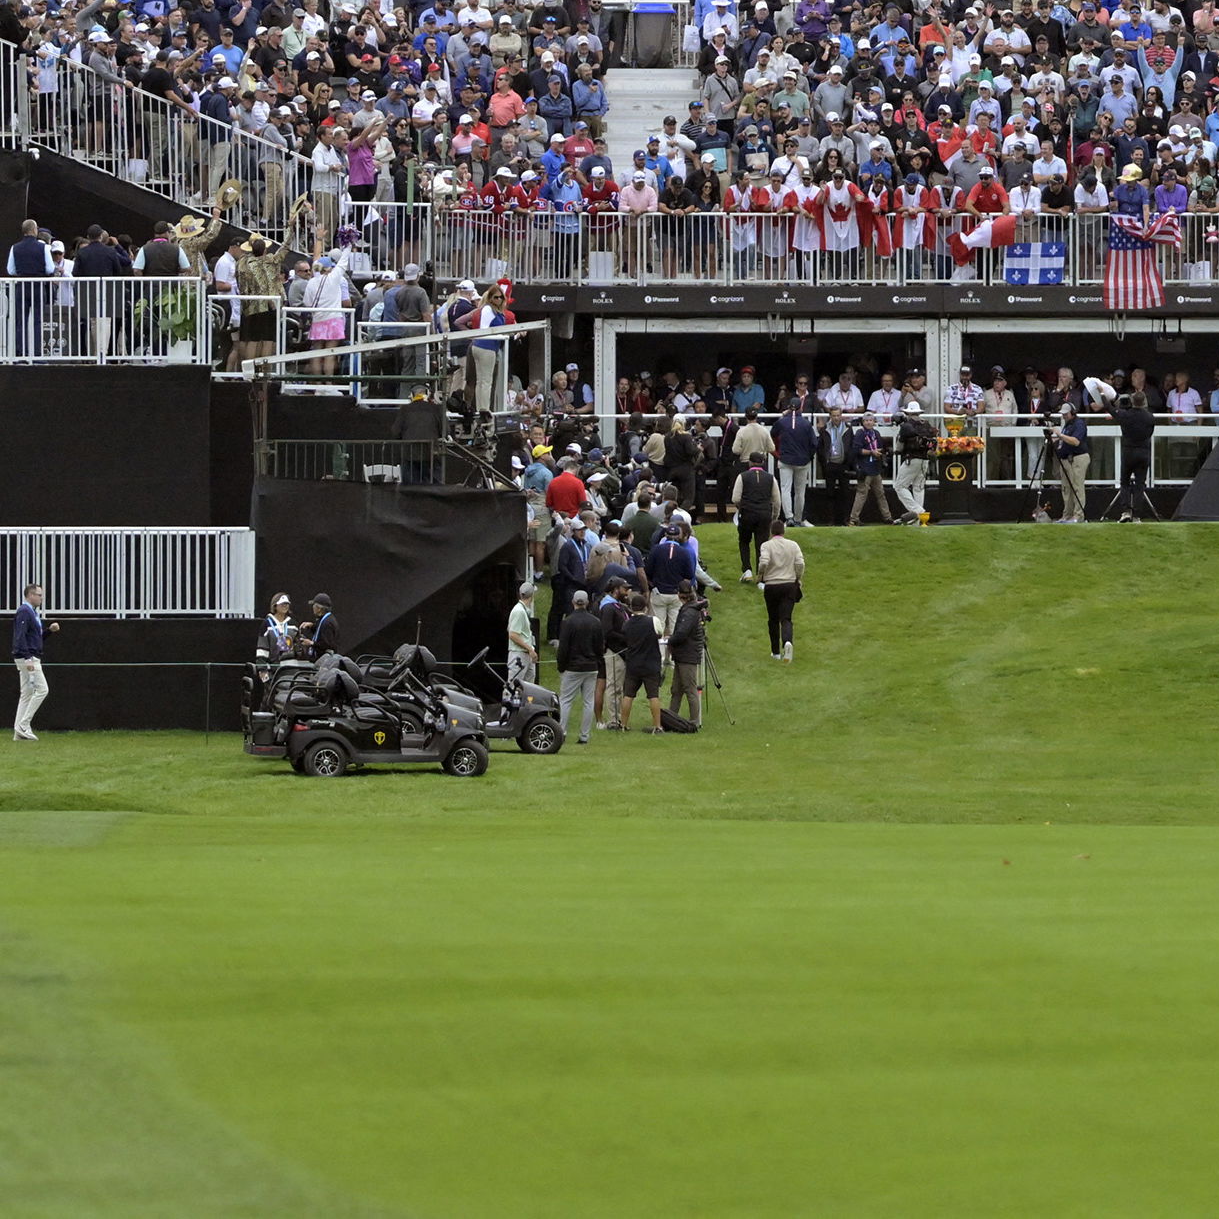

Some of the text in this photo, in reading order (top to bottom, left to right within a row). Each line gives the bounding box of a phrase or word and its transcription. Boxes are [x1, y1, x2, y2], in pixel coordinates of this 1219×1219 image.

[718, 295, 744, 304] cognizant
[900, 295, 926, 304] cognizant
[1077, 295, 1103, 304] cognizant
